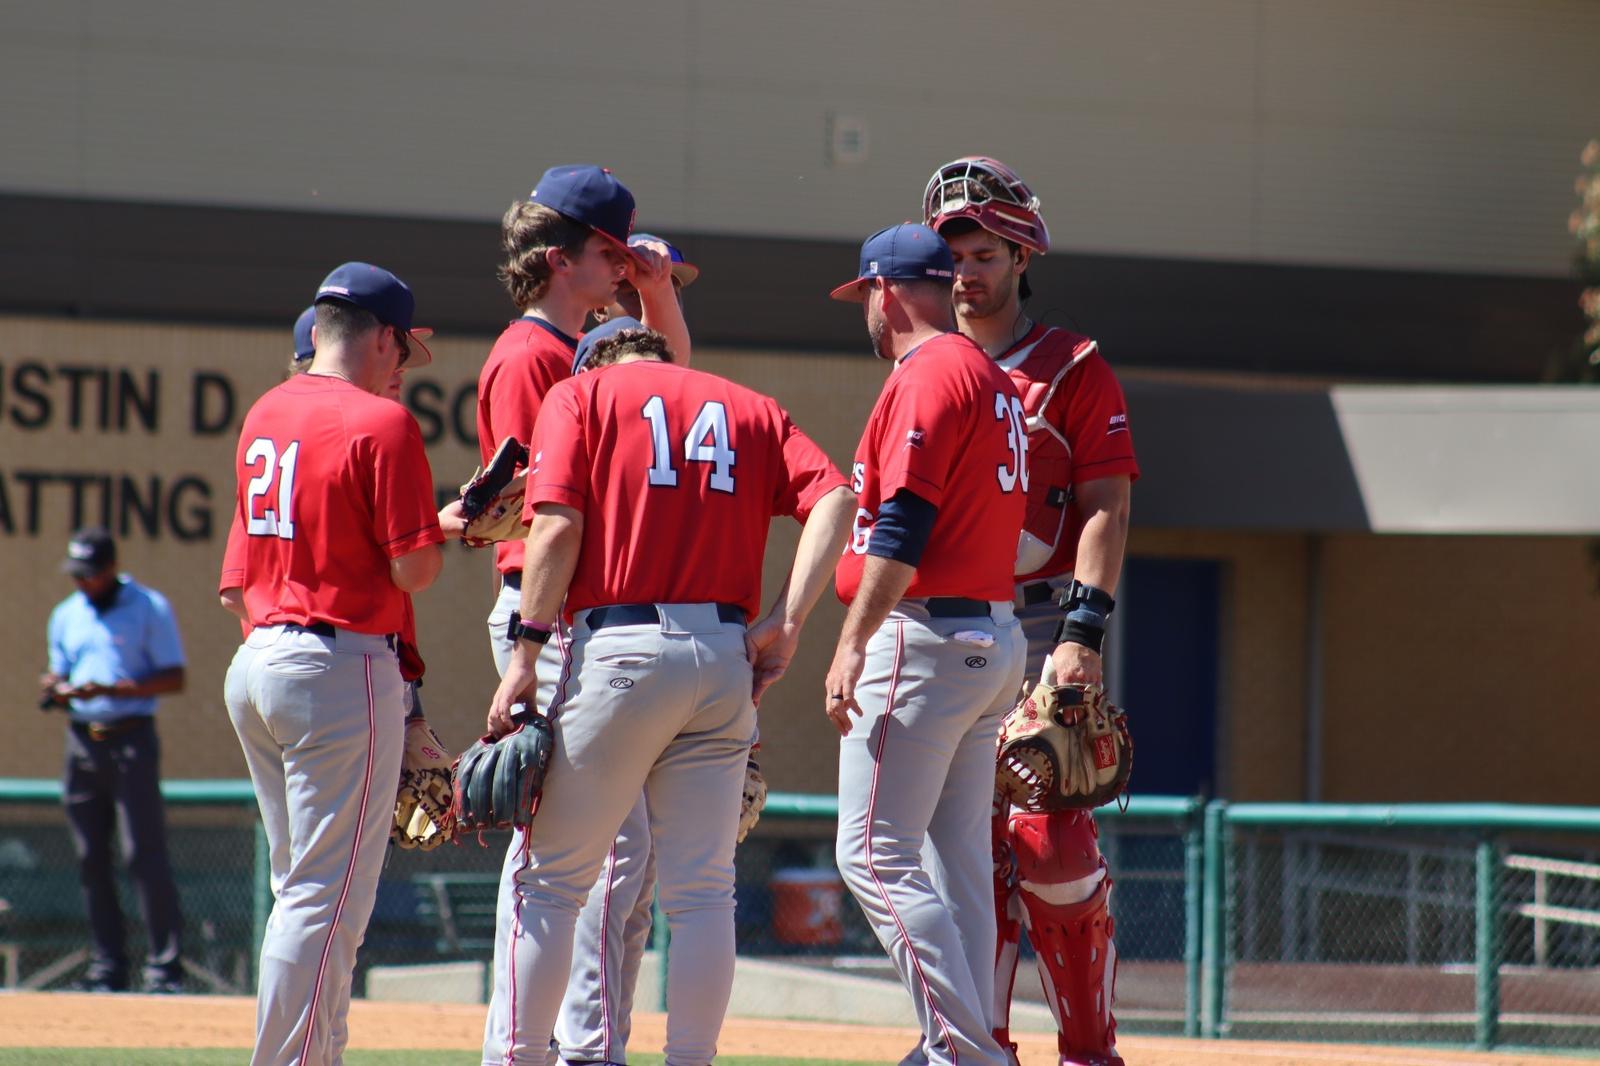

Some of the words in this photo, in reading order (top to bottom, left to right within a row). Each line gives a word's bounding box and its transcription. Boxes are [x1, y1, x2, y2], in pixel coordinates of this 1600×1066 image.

[0, 360, 159, 434] STIN
[640, 395, 736, 495] 14
[245, 437, 300, 541] 21
